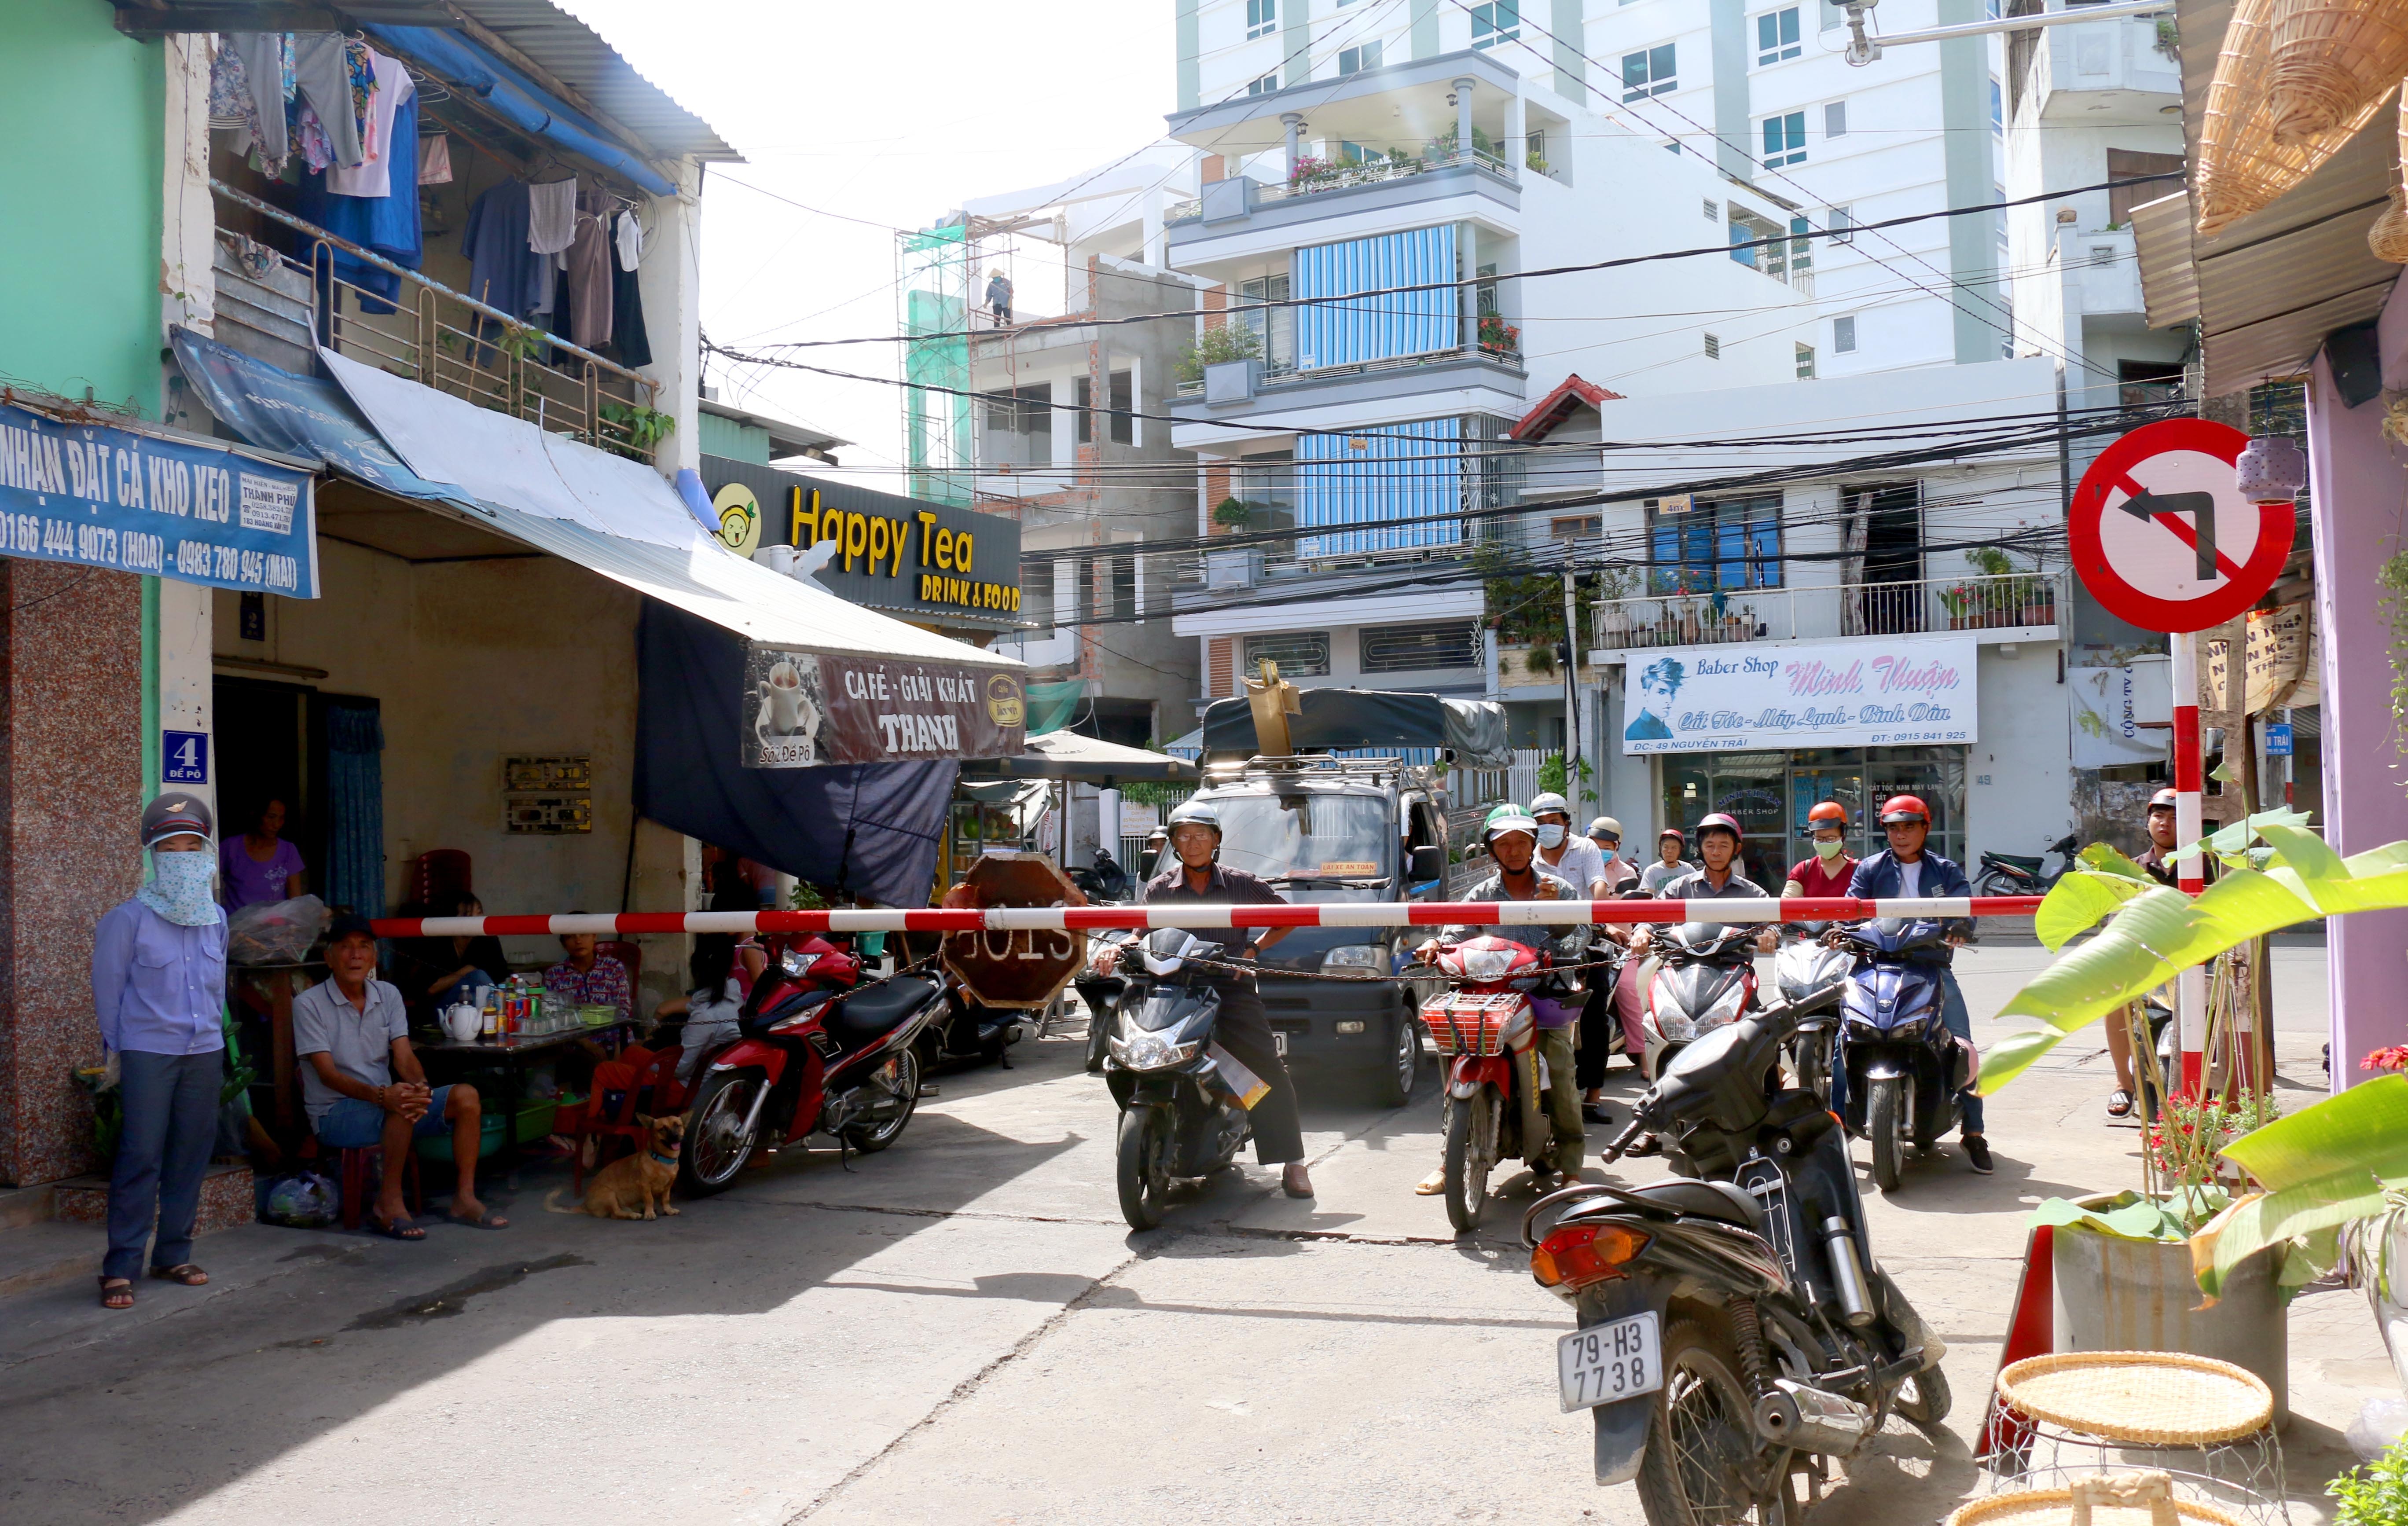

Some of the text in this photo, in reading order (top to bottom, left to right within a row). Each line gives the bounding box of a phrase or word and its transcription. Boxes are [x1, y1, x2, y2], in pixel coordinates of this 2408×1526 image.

[0, 419, 230, 523] NHẬN ĐẶT CÁ KHO XEO
[243, 487, 274, 503] THÀNH
[793, 484, 973, 577] Happy Tea
[0, 510, 39, 553] 0166
[44, 518, 74, 557] 444
[79, 524, 117, 564] 9073
[122, 531, 163, 573] (HOA)
[177, 539, 211, 576] 0983
[214, 545, 238, 580] 780
[241, 550, 264, 583] 945
[265, 554, 297, 591] (MAI)
[922, 574, 1020, 612] DRINK & FOOD
[845, 665, 890, 700] CAFÉ
[901, 667, 933, 701] GIẢI
[936, 671, 975, 702] KHÁT
[1696, 655, 1960, 699] Baber Shop Minh Thuận
[2124, 677, 2132, 696] TY
[879, 714, 959, 753] THANH
[1678, 711, 1709, 730] Cắt
[1711, 711, 1744, 729] Tóc
[1753, 708, 1796, 730] Máy
[1797, 706, 1846, 730] Lạnh
[1860, 704, 1905, 723] Bình
[1909, 703, 1950, 722] Dân
[174, 738, 198, 767] 4
[782, 743, 797, 762] Đề
[799, 745, 810, 761] Pô
[1671, 738, 1718, 748] NGUYỄN
[1722, 739, 1747, 748] TRÃI
[170, 767, 201, 779] ĐỀ PÔ
[1978, 775, 1991, 785] 49
[1718, 790, 1743, 807] MINH
[1529, 1047, 1539, 1111] HONDA
[1572, 1322, 1642, 1368] 79-H3
[1574, 1357, 1644, 1402] 7738
